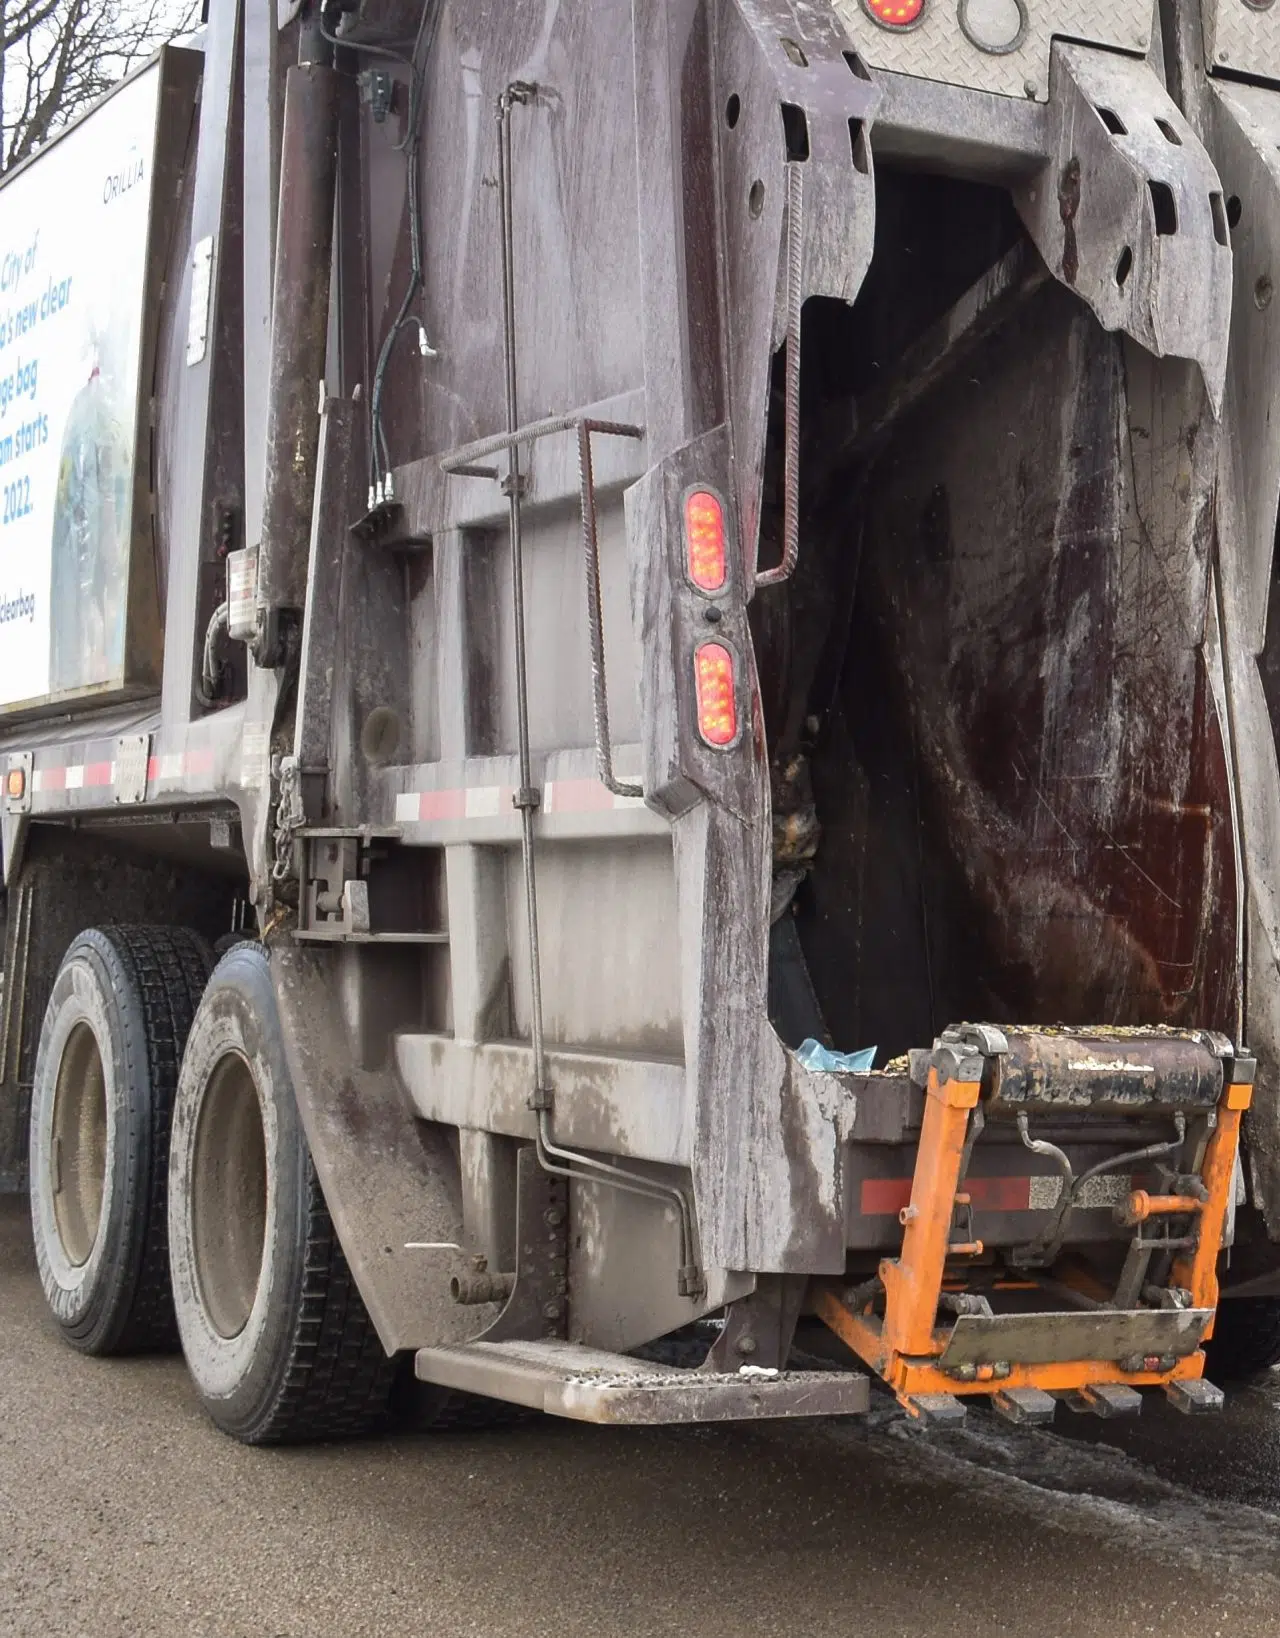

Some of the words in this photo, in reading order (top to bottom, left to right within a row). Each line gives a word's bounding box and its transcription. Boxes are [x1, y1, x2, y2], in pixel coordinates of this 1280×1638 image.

[103, 158, 144, 205] ORILLIA
[1, 250, 23, 294] City
[24, 227, 41, 275] of
[14, 297, 39, 339] new
[40, 274, 72, 321] clear
[16, 356, 38, 400] bag
[15, 411, 48, 458] starts
[3, 474, 34, 524] 2022.
